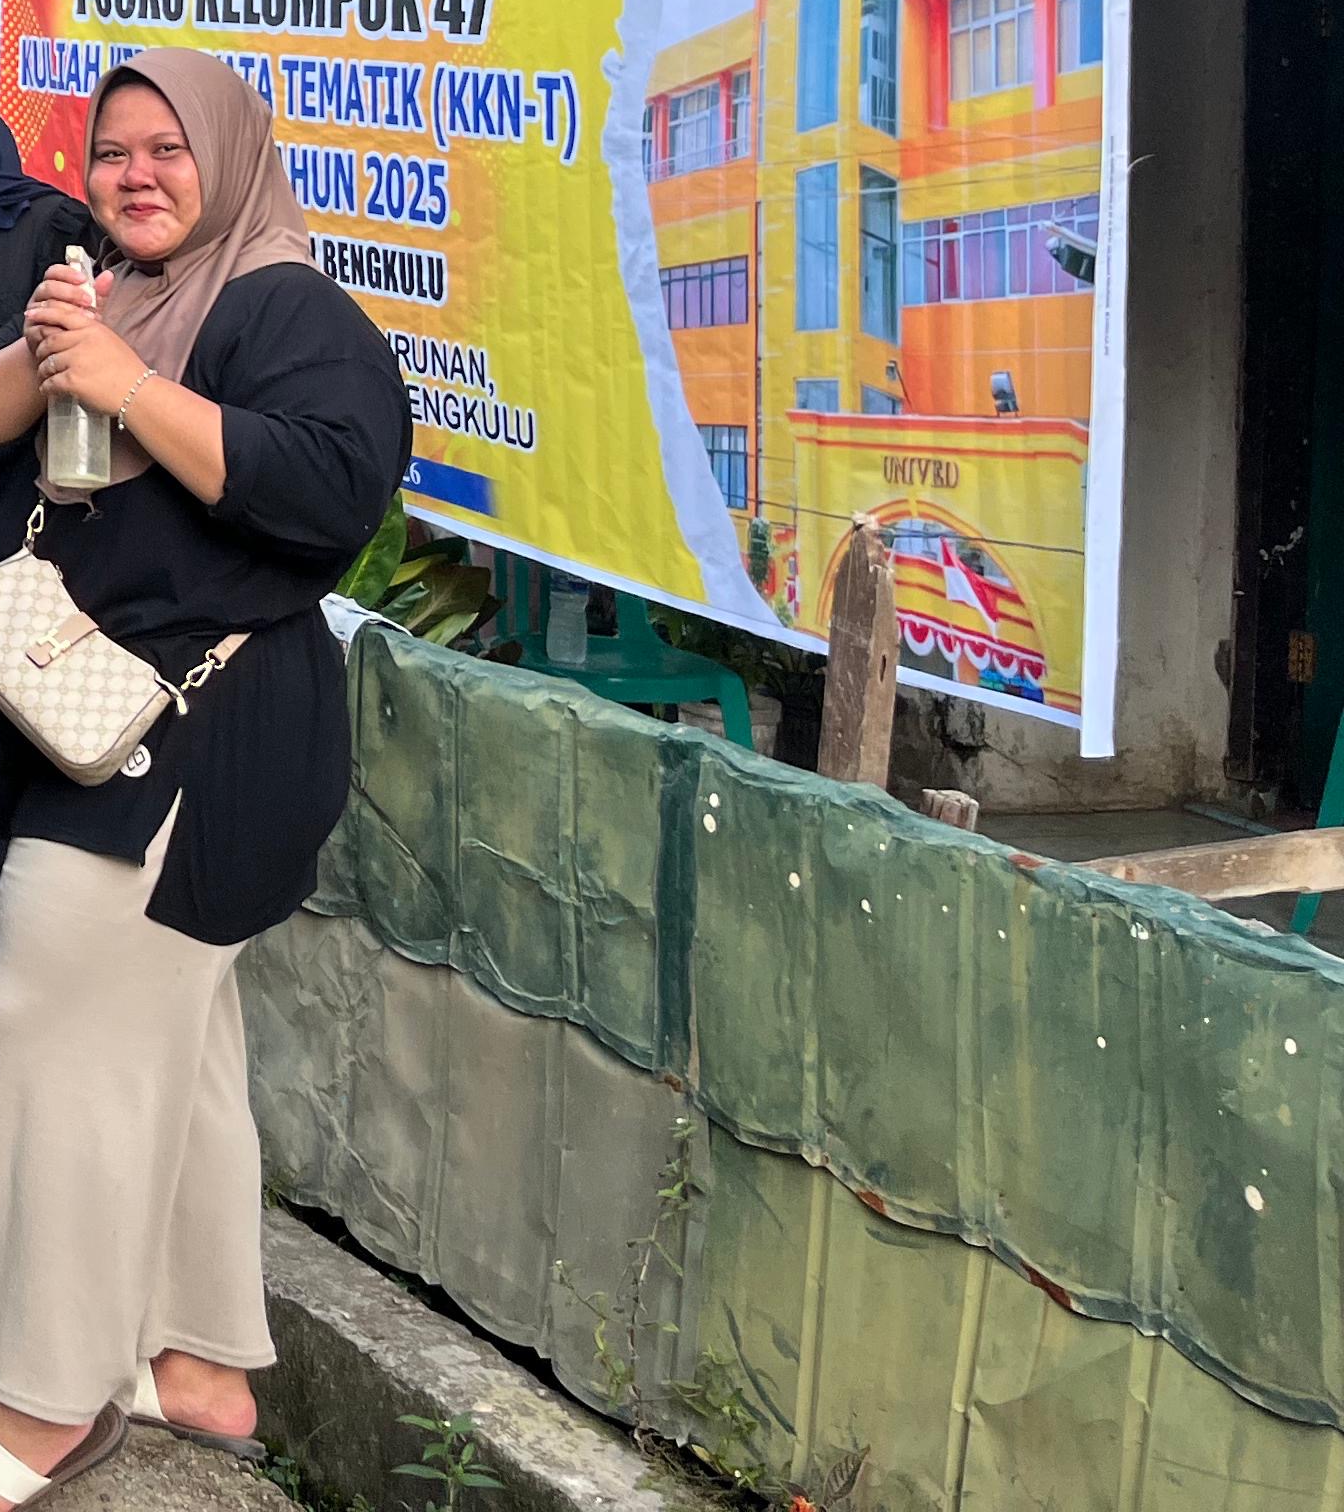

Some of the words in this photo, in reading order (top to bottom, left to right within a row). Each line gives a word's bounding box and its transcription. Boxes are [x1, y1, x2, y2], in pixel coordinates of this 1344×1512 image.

[21, 38, 101, 94] KULIAH
[281, 59, 423, 128] TEMATIK
[433, 66, 578, 160] (KKN-T)
[276, 145, 355, 212] HUN
[366, 155, 447, 225] 2025
[322, 238, 444, 301] BENGKULU
[387, 331, 495, 397] RUNAN,
[402, 461, 421, 485] 6
